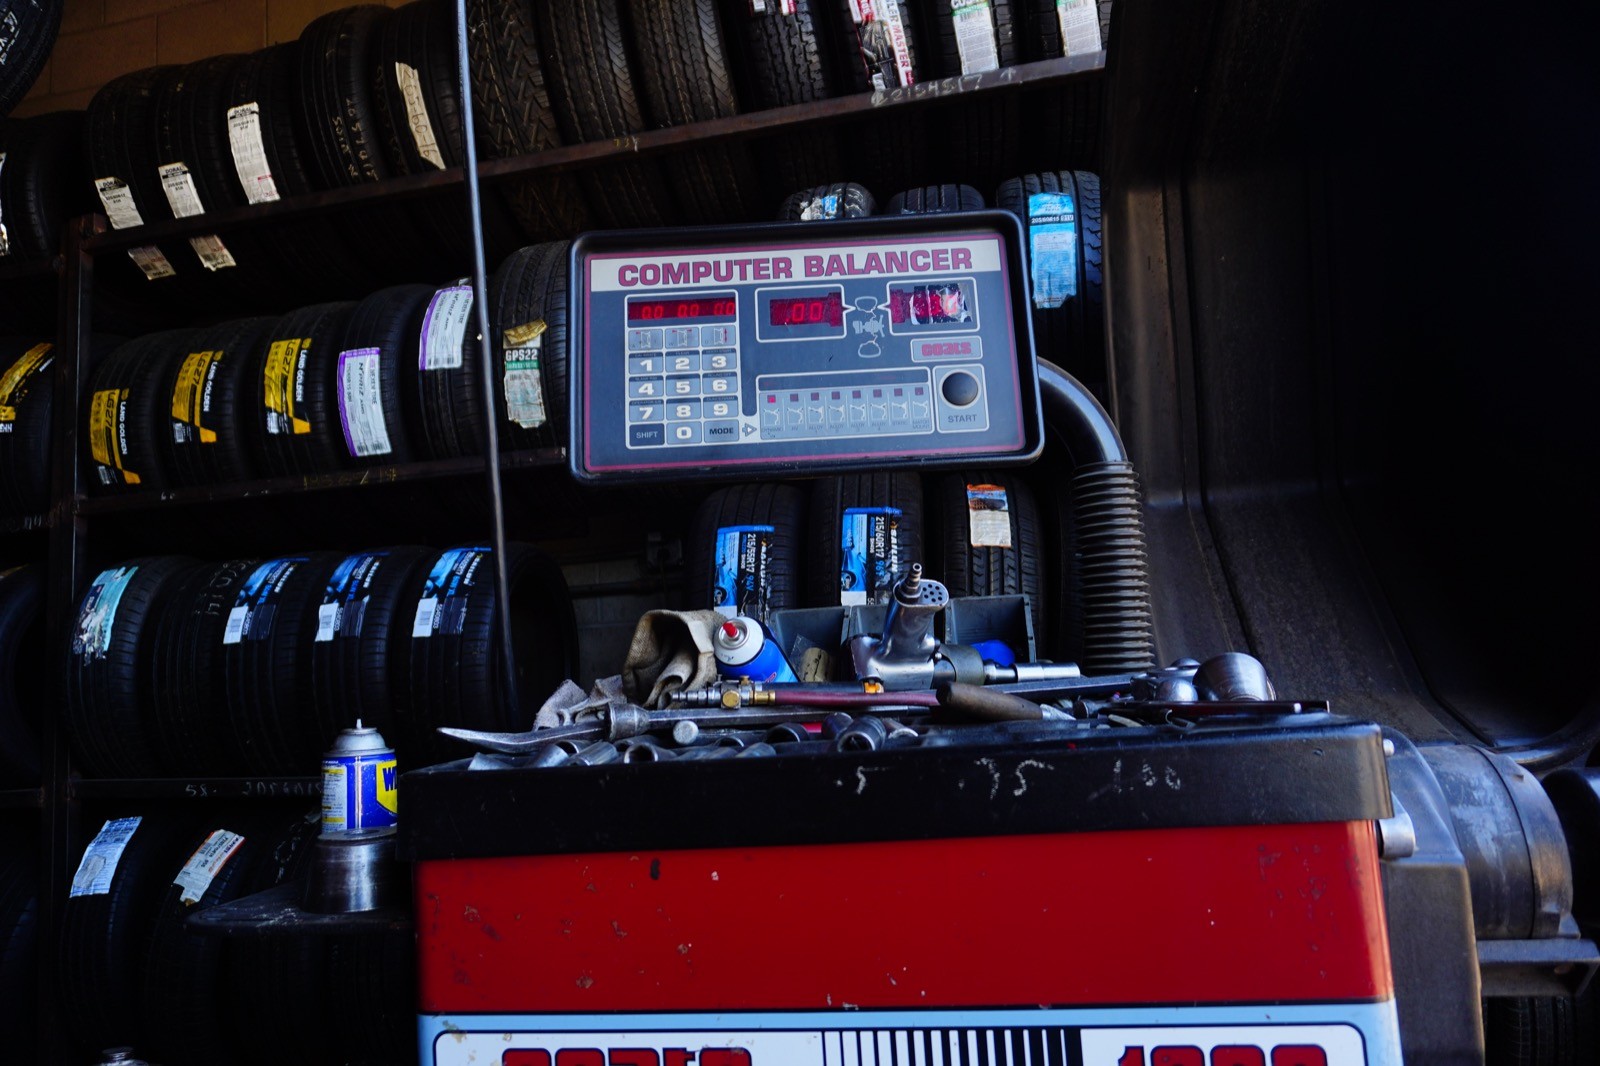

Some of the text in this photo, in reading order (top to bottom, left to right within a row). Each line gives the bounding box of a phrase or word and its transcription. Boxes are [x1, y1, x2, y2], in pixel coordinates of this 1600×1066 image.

[618, 247, 973, 287] COMPUTER BALANCER
[505, 348, 539, 362] GPS22
[711, 355, 727, 368] 3
[639, 359, 653, 372] 1
[675, 357, 690, 370] 2
[296, 350, 307, 402] LAND GOLDEN
[204, 362, 218, 412] LAND GOLDEN
[638, 382, 654, 395] 4
[676, 381, 691, 393] 5
[712, 379, 727, 392] 6
[638, 407, 653, 420] 7
[676, 404, 691, 417] 8
[713, 403, 728, 416] 9
[947, 414, 978, 423] START
[636, 431, 659, 439] SHIFT
[676, 426, 692, 439] 0
[709, 427, 734, 435] MODE
[119, 423, 128, 455] GOLDEN
[875, 516, 885, 558] 215/60R17
[890, 529, 898, 572] SAILUN
[746, 533, 756, 591] 215/55R17 94V
[383, 767, 398, 791] W
